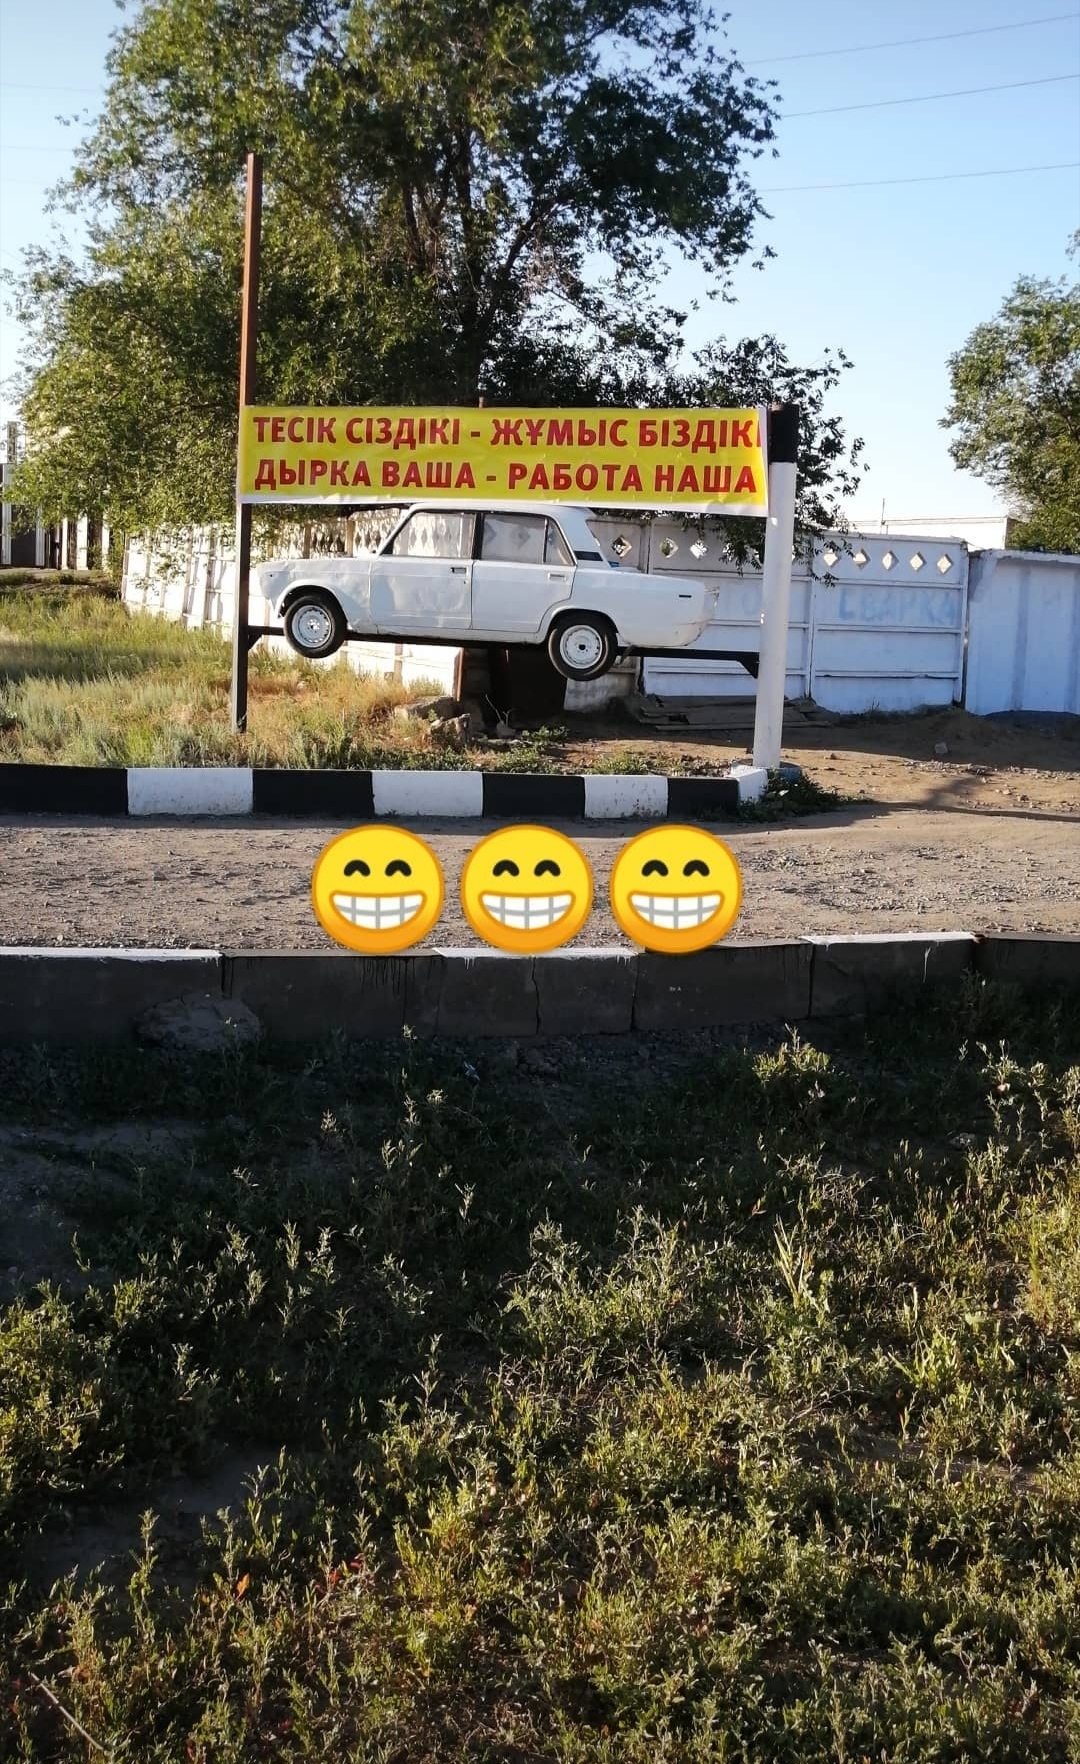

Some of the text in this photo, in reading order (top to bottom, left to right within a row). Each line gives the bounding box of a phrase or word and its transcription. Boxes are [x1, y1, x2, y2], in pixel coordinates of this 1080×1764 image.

[253, 417, 336, 443] ТЕСІК
[346, 418, 460, 450] СІЗДІКІ
[490, 419, 628, 447] ЖҰМЫС
[254, 459, 371, 490] ДЫРКА
[382, 461, 476, 488] ВАША
[508, 463, 643, 492] РАБОТА
[654, 465, 756, 493] НАША
